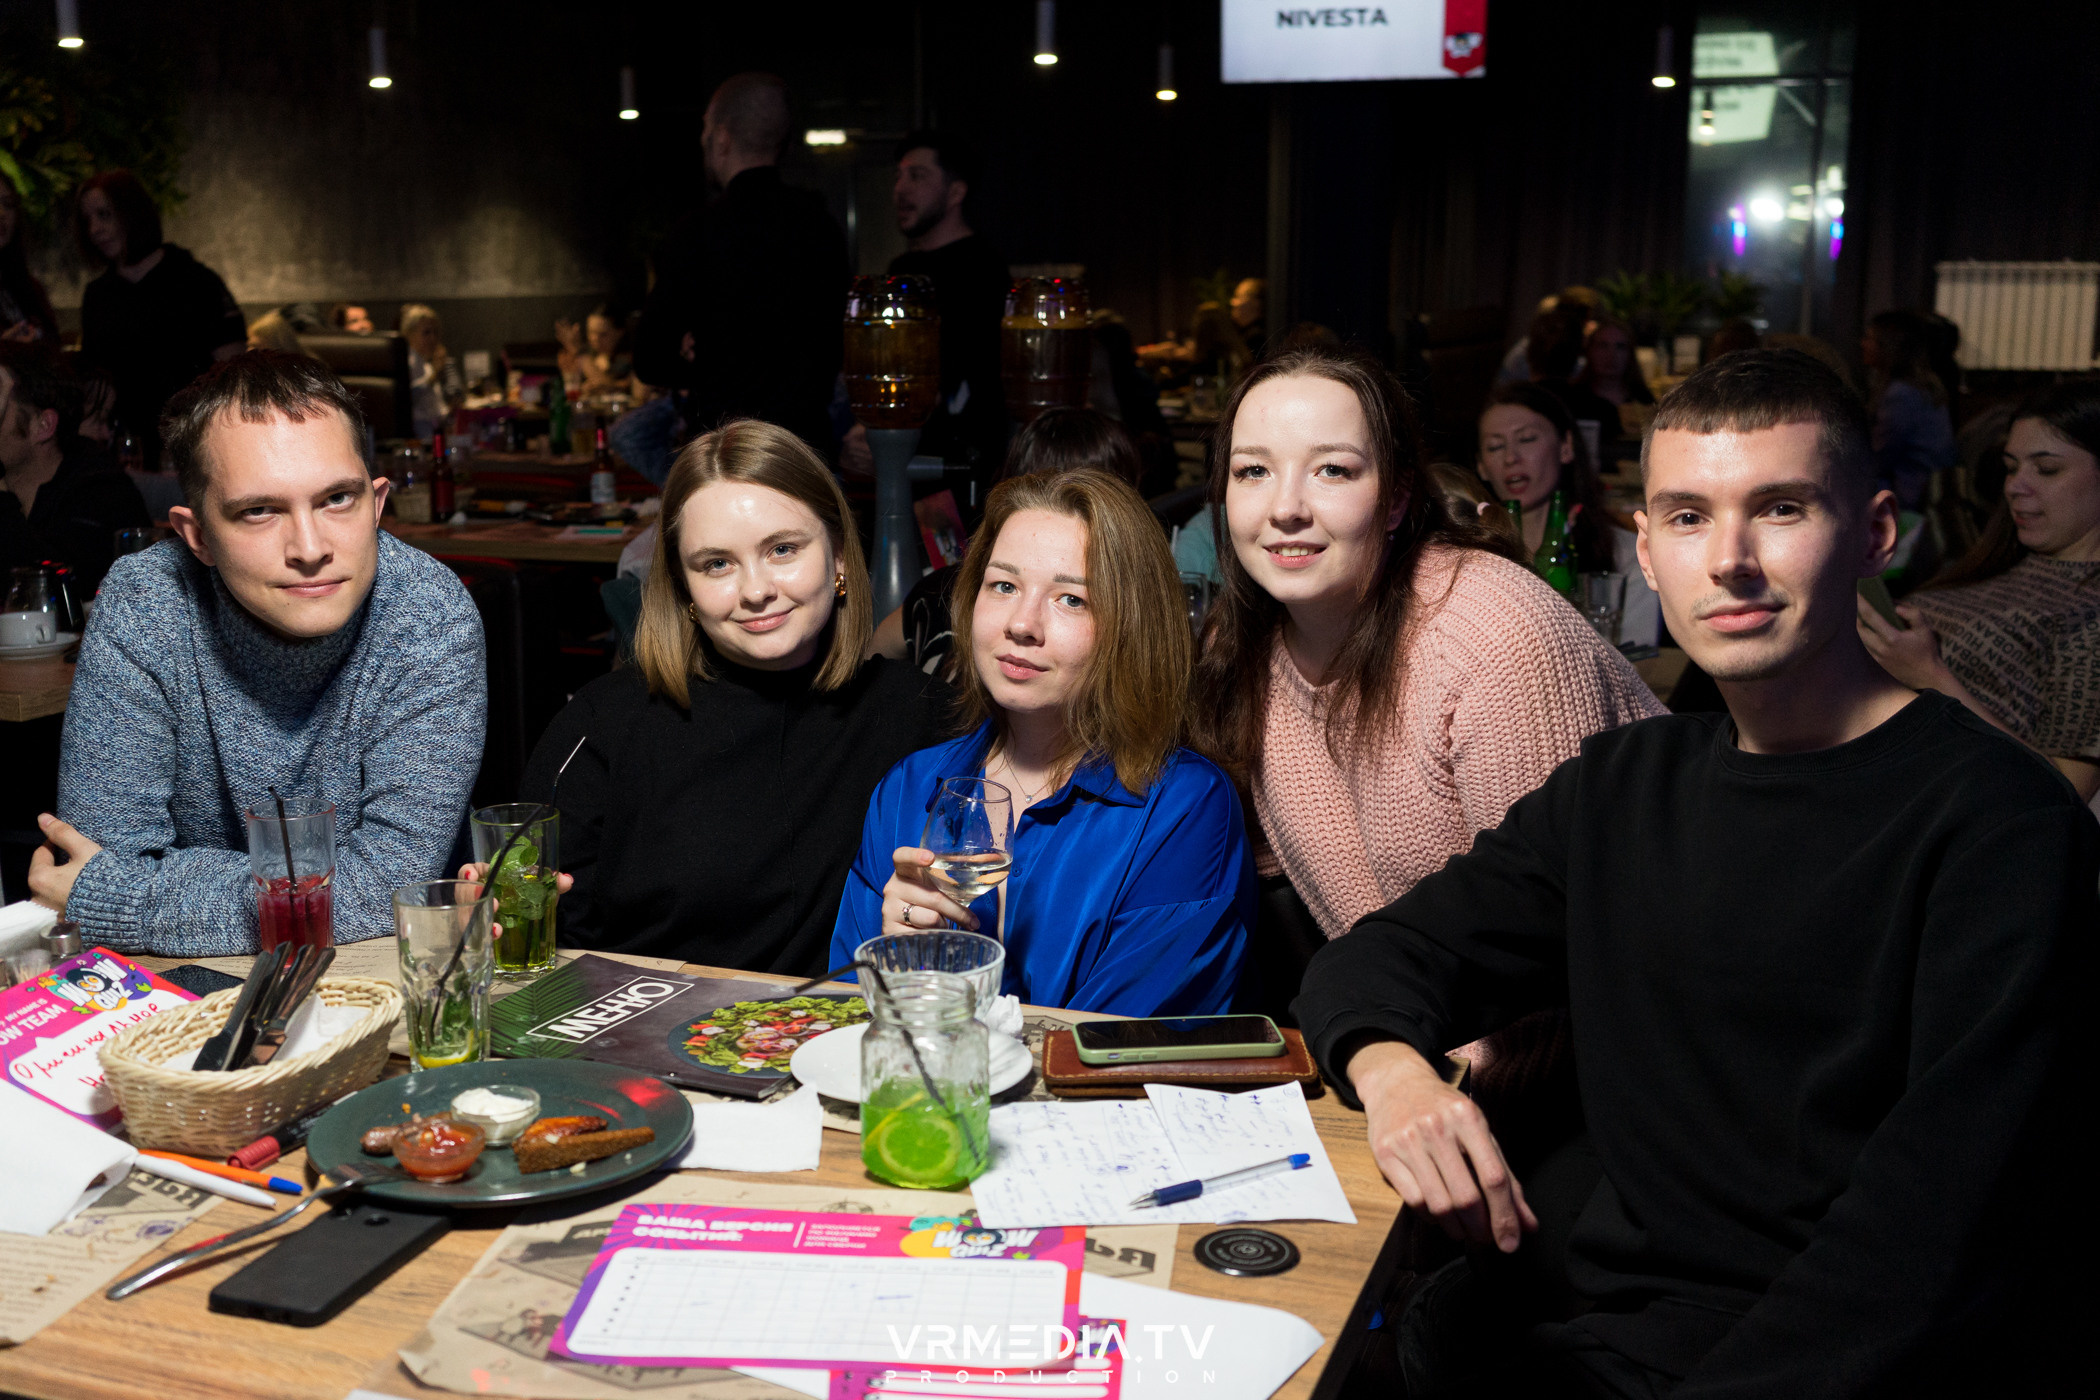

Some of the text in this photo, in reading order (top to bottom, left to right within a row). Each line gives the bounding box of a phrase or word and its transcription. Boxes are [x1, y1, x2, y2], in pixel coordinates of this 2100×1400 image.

[1276, 8, 1388, 28] NIVESTA
[93, 980, 134, 1009] QUIZ
[4, 1011, 19, 1022] MY
[16, 1001, 42, 1016] NAME
[17, 1003, 68, 1030] TEAM
[547, 982, 675, 1039] МЕНЮ
[636, 1215, 794, 1233] ВАША ВЕРСИЯ
